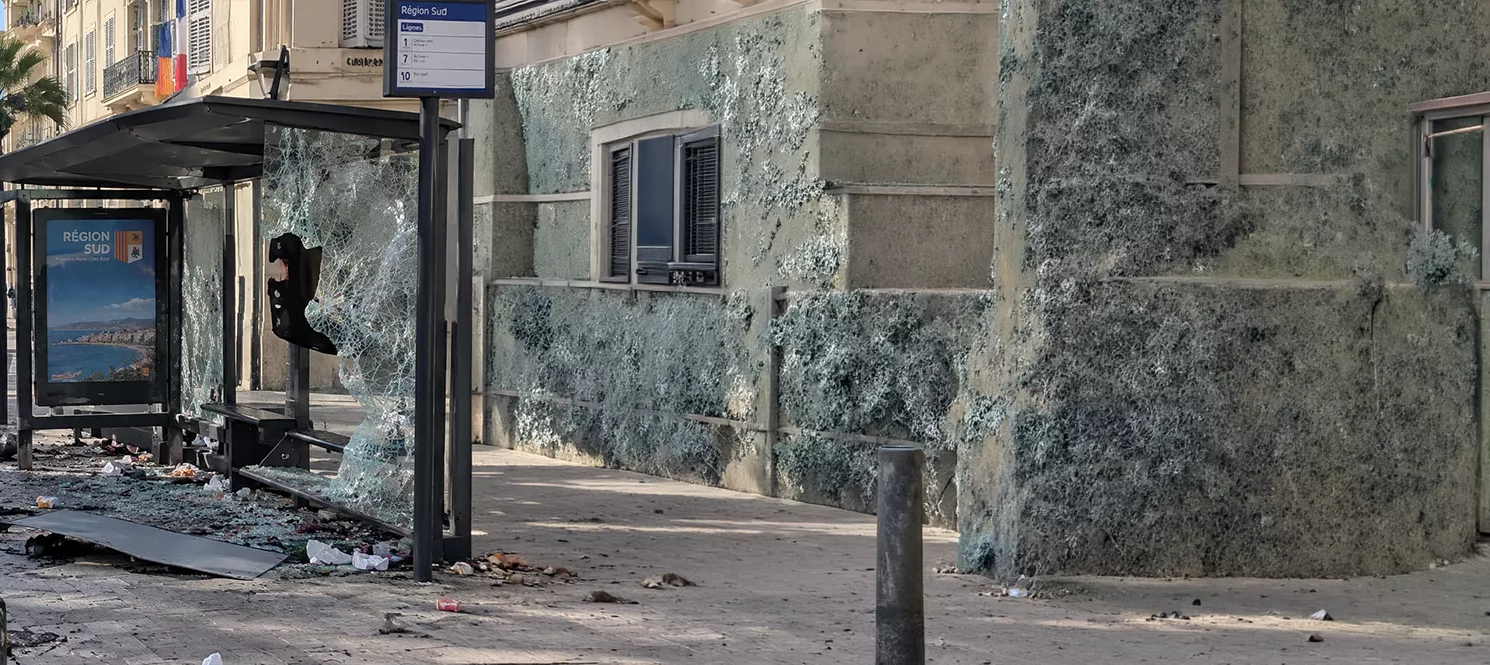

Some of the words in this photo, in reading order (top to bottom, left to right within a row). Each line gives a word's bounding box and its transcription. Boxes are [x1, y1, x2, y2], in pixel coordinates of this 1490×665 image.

[401, 5, 429, 16] Région
[431, 7, 447, 15] Sud
[402, 23, 422, 31] Lignes
[404, 38, 408, 46] 1
[403, 54, 408, 63] 7
[401, 71, 410, 80] 10
[63, 229, 110, 241] RÉGION
[84, 243, 110, 254] SUD
